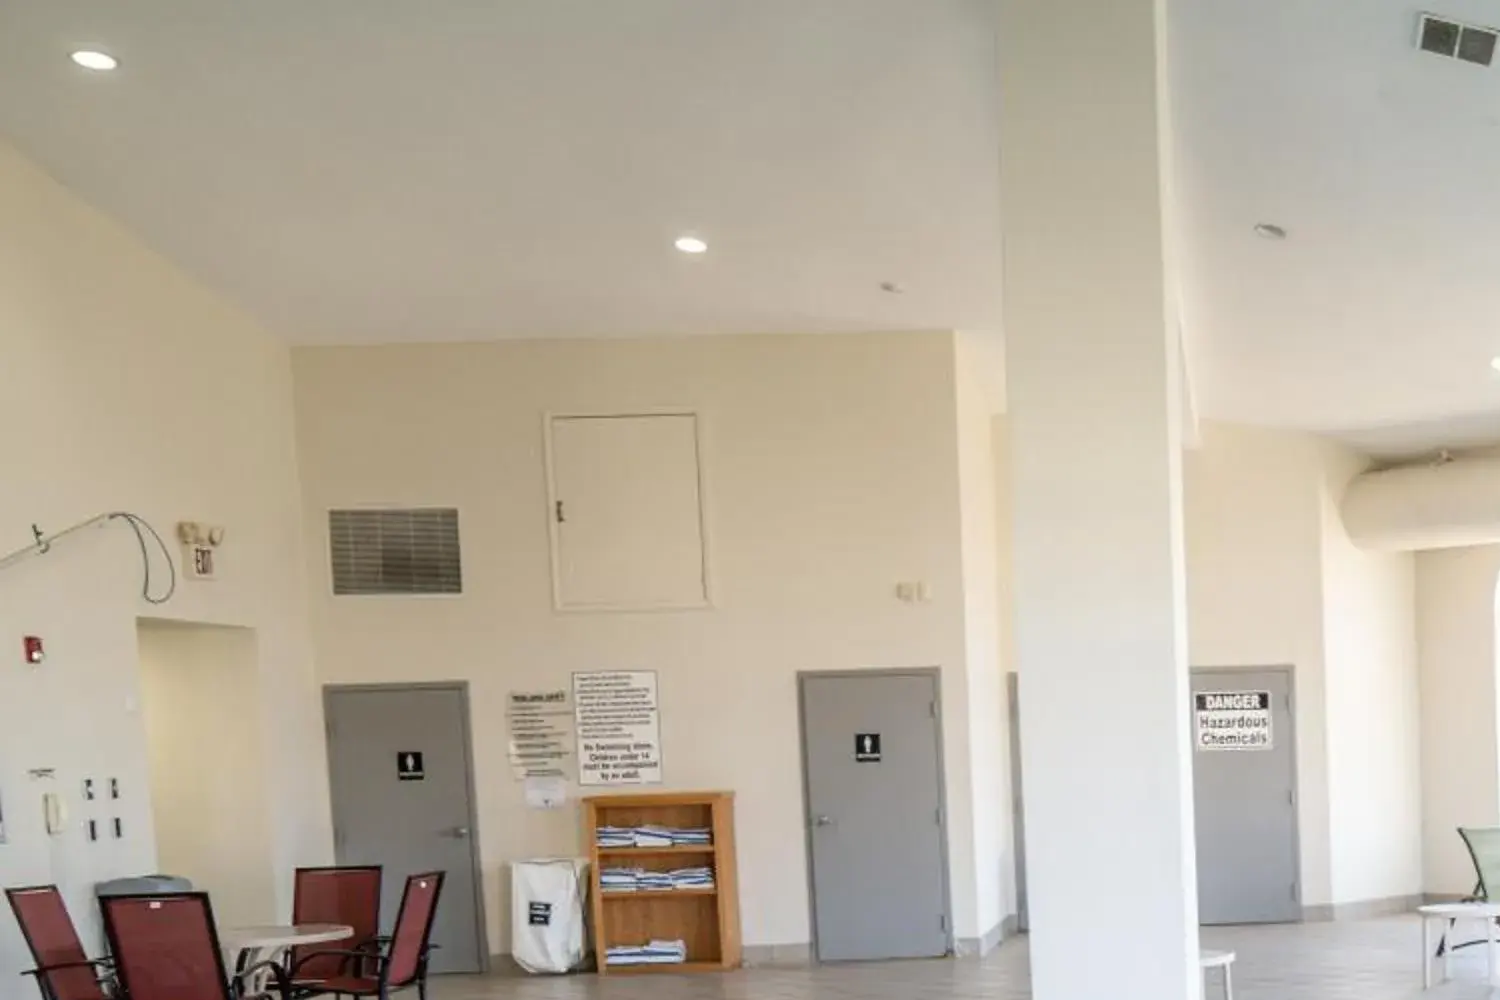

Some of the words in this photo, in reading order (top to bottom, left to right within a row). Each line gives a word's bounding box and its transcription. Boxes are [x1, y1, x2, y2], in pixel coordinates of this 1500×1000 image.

[1205, 695, 1260, 708] DANGER
[1200, 716, 1267, 728] Hazardous
[1202, 732, 1266, 744] Chemicals
